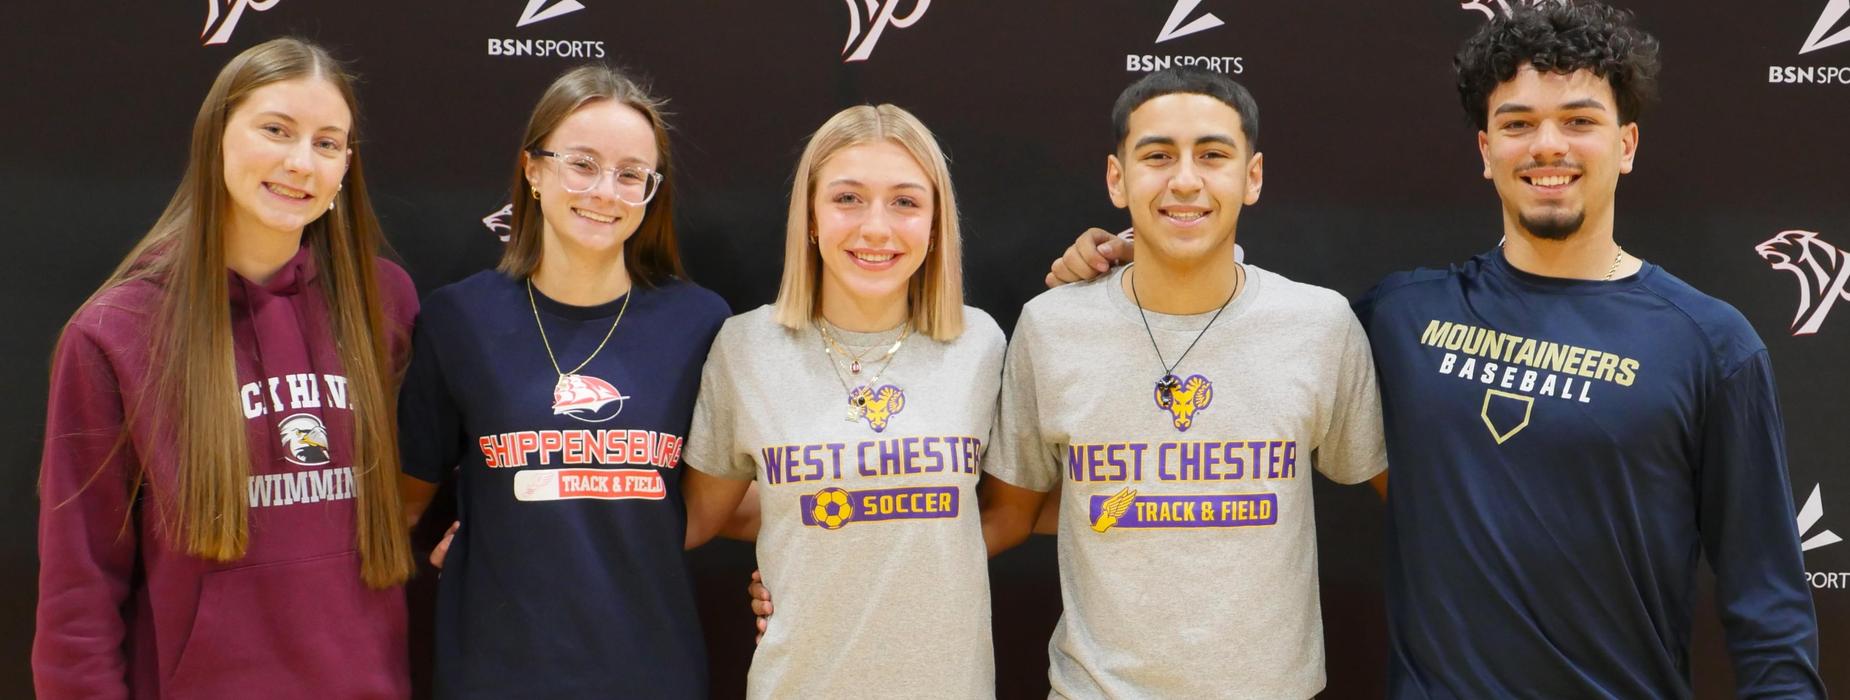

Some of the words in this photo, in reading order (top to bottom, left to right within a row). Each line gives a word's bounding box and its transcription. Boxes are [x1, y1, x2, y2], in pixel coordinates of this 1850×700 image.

[487, 38, 532, 56] BSN
[535, 39, 605, 58] SPORTS
[1126, 54, 1171, 72] BSN
[1768, 65, 1814, 83] BSN
[1421, 319, 1640, 387] MOUNTAINEERS
[240, 376, 284, 419] CK
[1439, 352, 1592, 404] BASEBALL
[478, 429, 684, 470] SHIPPENSBURG
[761, 442, 846, 486] WEST
[856, 434, 981, 478] CHESTER
[1157, 439, 1298, 482] CHESTER
[247, 466, 358, 508] WIMMIN
[561, 474, 610, 493] TRACK
[612, 474, 622, 492] &
[863, 491, 952, 516] SOCCER
[1135, 501, 1196, 523] TRACK
[1201, 501, 1215, 522] &
[1221, 499, 1271, 521] FIELD
